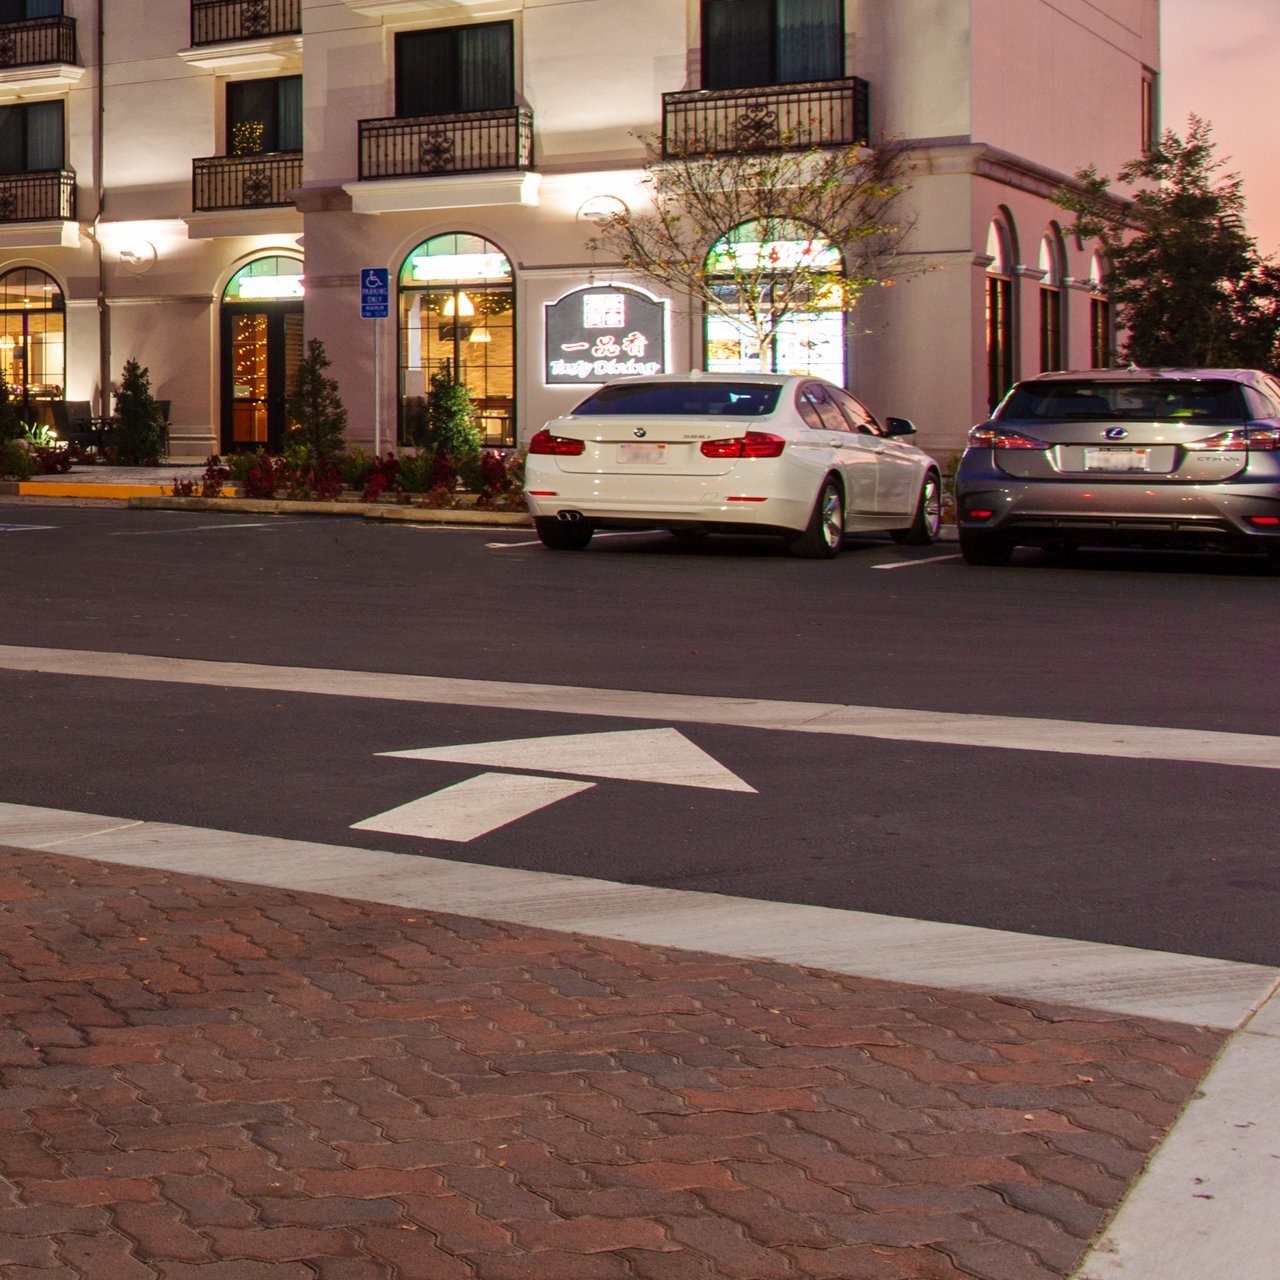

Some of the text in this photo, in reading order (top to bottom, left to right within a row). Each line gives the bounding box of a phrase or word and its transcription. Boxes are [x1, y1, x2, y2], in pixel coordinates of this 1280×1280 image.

[367, 296, 383, 304] ONLY
[561, 331, 649, 357] 一品香
[549, 358, 662, 379] Tasty Dining
